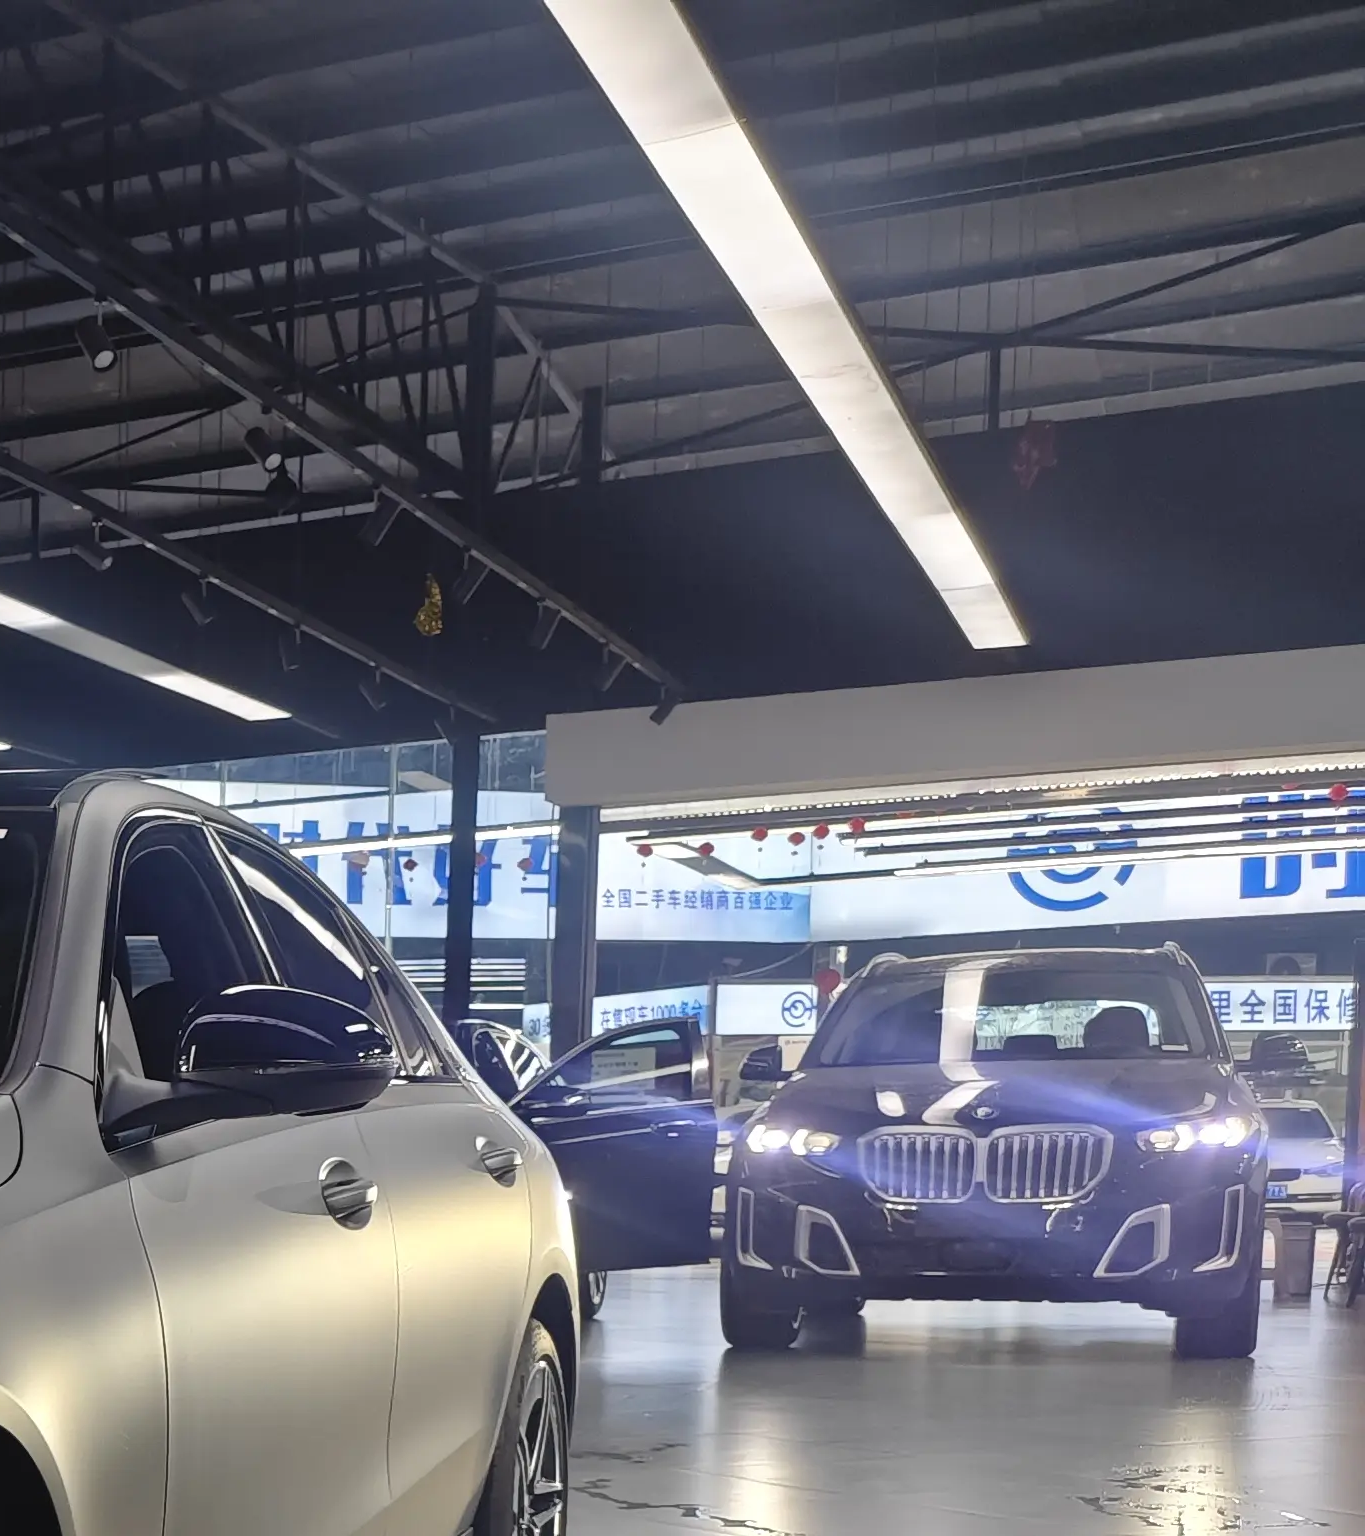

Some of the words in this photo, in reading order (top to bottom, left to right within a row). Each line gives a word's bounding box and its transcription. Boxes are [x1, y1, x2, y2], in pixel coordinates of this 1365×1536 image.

[601, 888, 794, 911] 全国二手车经销商百强企业
